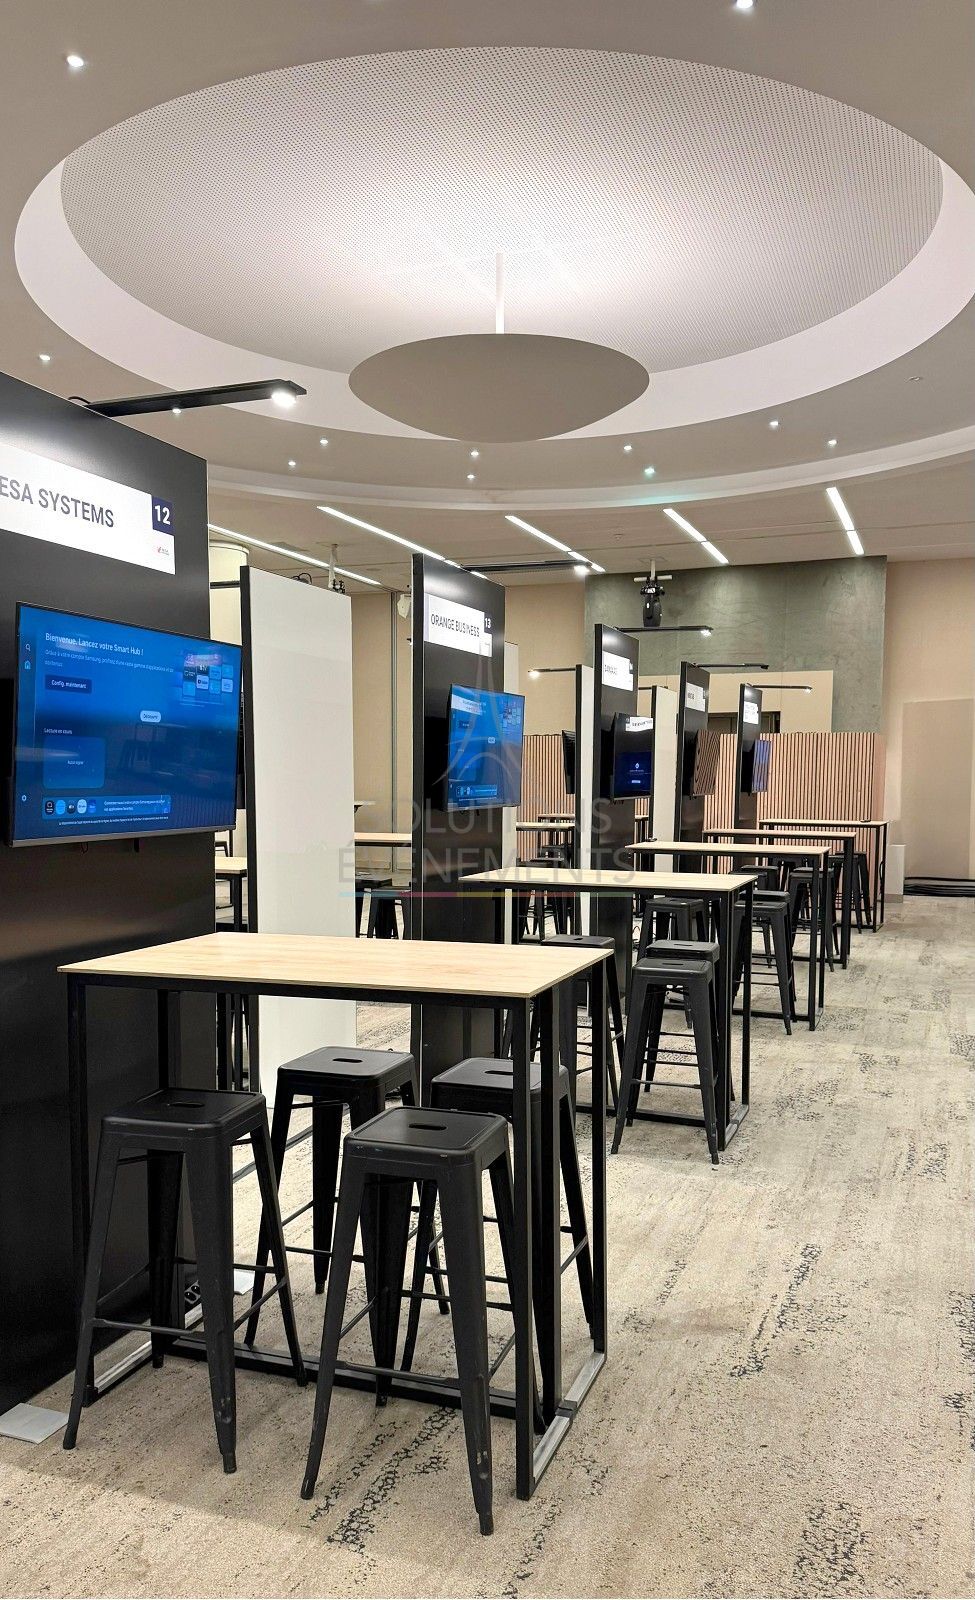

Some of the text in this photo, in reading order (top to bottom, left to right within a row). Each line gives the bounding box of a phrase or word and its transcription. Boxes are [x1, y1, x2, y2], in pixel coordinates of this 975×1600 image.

[0, 475, 114, 528] ESA SYSTEMS
[154, 505, 171, 525] 12
[430, 613, 480, 637] ORANGE BUSINESS
[484, 617, 492, 629] 13
[78, 638, 98, 649] Lancez
[113, 644, 130, 654] Smart
[130, 645, 140, 656] Hub
